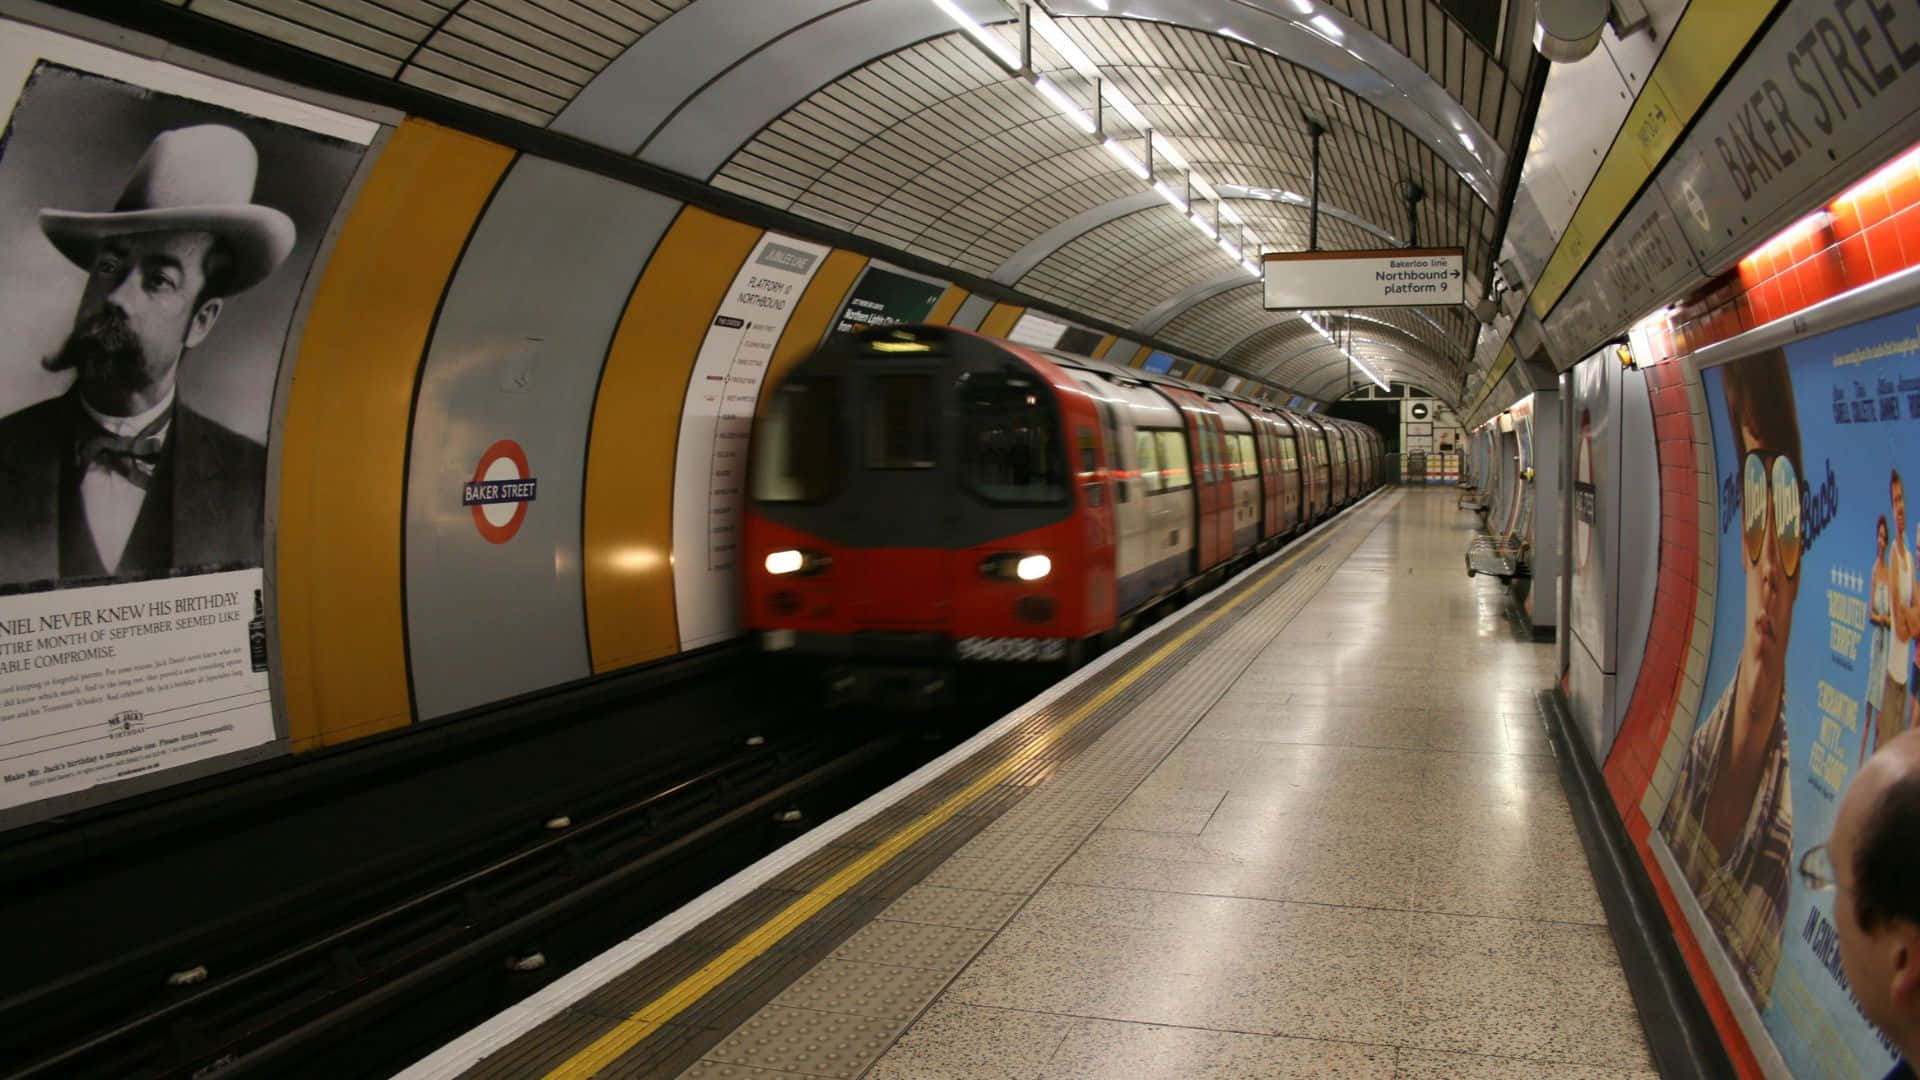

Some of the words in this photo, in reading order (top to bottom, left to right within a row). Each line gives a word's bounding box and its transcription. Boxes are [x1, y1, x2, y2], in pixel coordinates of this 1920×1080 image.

[1714, 79, 1812, 200] BAKER
[1390, 260, 1428, 268] Bakerloo
[1431, 257, 1448, 268] line
[748, 276, 784, 293] PLATFORM
[1376, 271, 1448, 281] Northbound
[1385, 283, 1436, 295] platform
[1440, 282, 1448, 293] 9
[737, 292, 786, 310] NORTHBOUND
[465, 485, 499, 501] BAKER
[501, 483, 535, 498] STREET
[1801, 457, 1838, 556] Back
[40, 610, 93, 632] NEVER
[97, 604, 145, 624] KNEW
[149, 600, 172, 617] HIS
[175, 592, 239, 613] BIRTHDAY
[0, 640, 33, 656] TIRE
[37, 632, 87, 650] MONTH
[90, 630, 105, 642] OF
[110, 620, 173, 640] SEPTEMBER
[175, 615, 216, 631] SEEMED
[218, 610, 241, 623] LIKE
[0, 658, 31, 674] ABLE
[34, 646, 117, 668] COMPROMISE
[1802, 905, 1821, 944] IN
